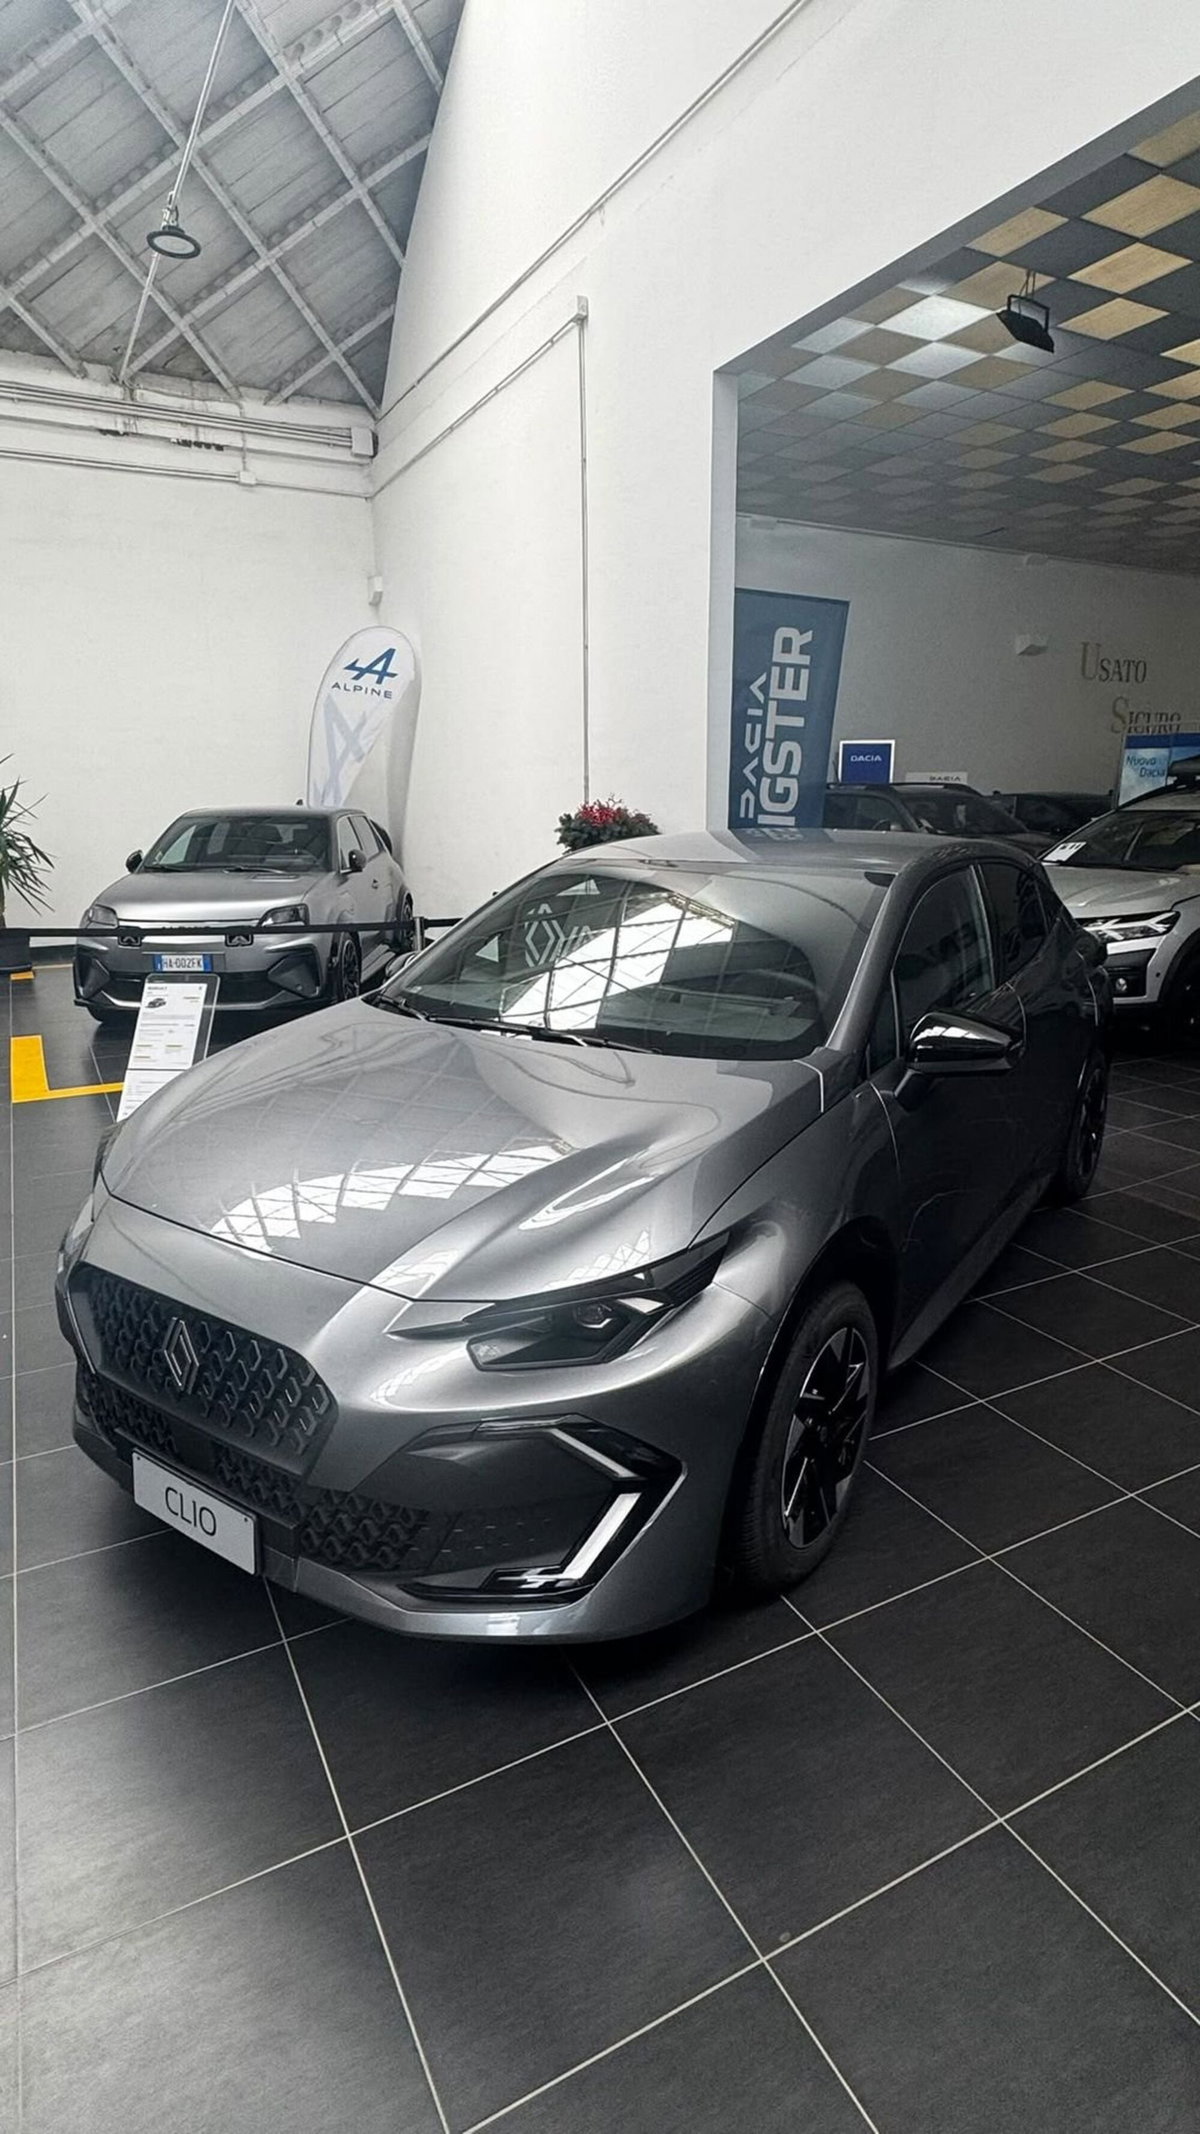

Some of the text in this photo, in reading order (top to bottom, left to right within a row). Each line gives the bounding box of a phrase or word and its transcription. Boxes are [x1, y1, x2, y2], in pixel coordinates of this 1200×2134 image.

[1080, 641, 1148, 684] USATO
[331, 681, 393, 699] ALPINE
[739, 671, 767, 819] DACIA
[757, 626, 813, 827] IGSTER
[850, 754, 882, 763] DACIA
[165, 1486, 217, 1537] CLIO
